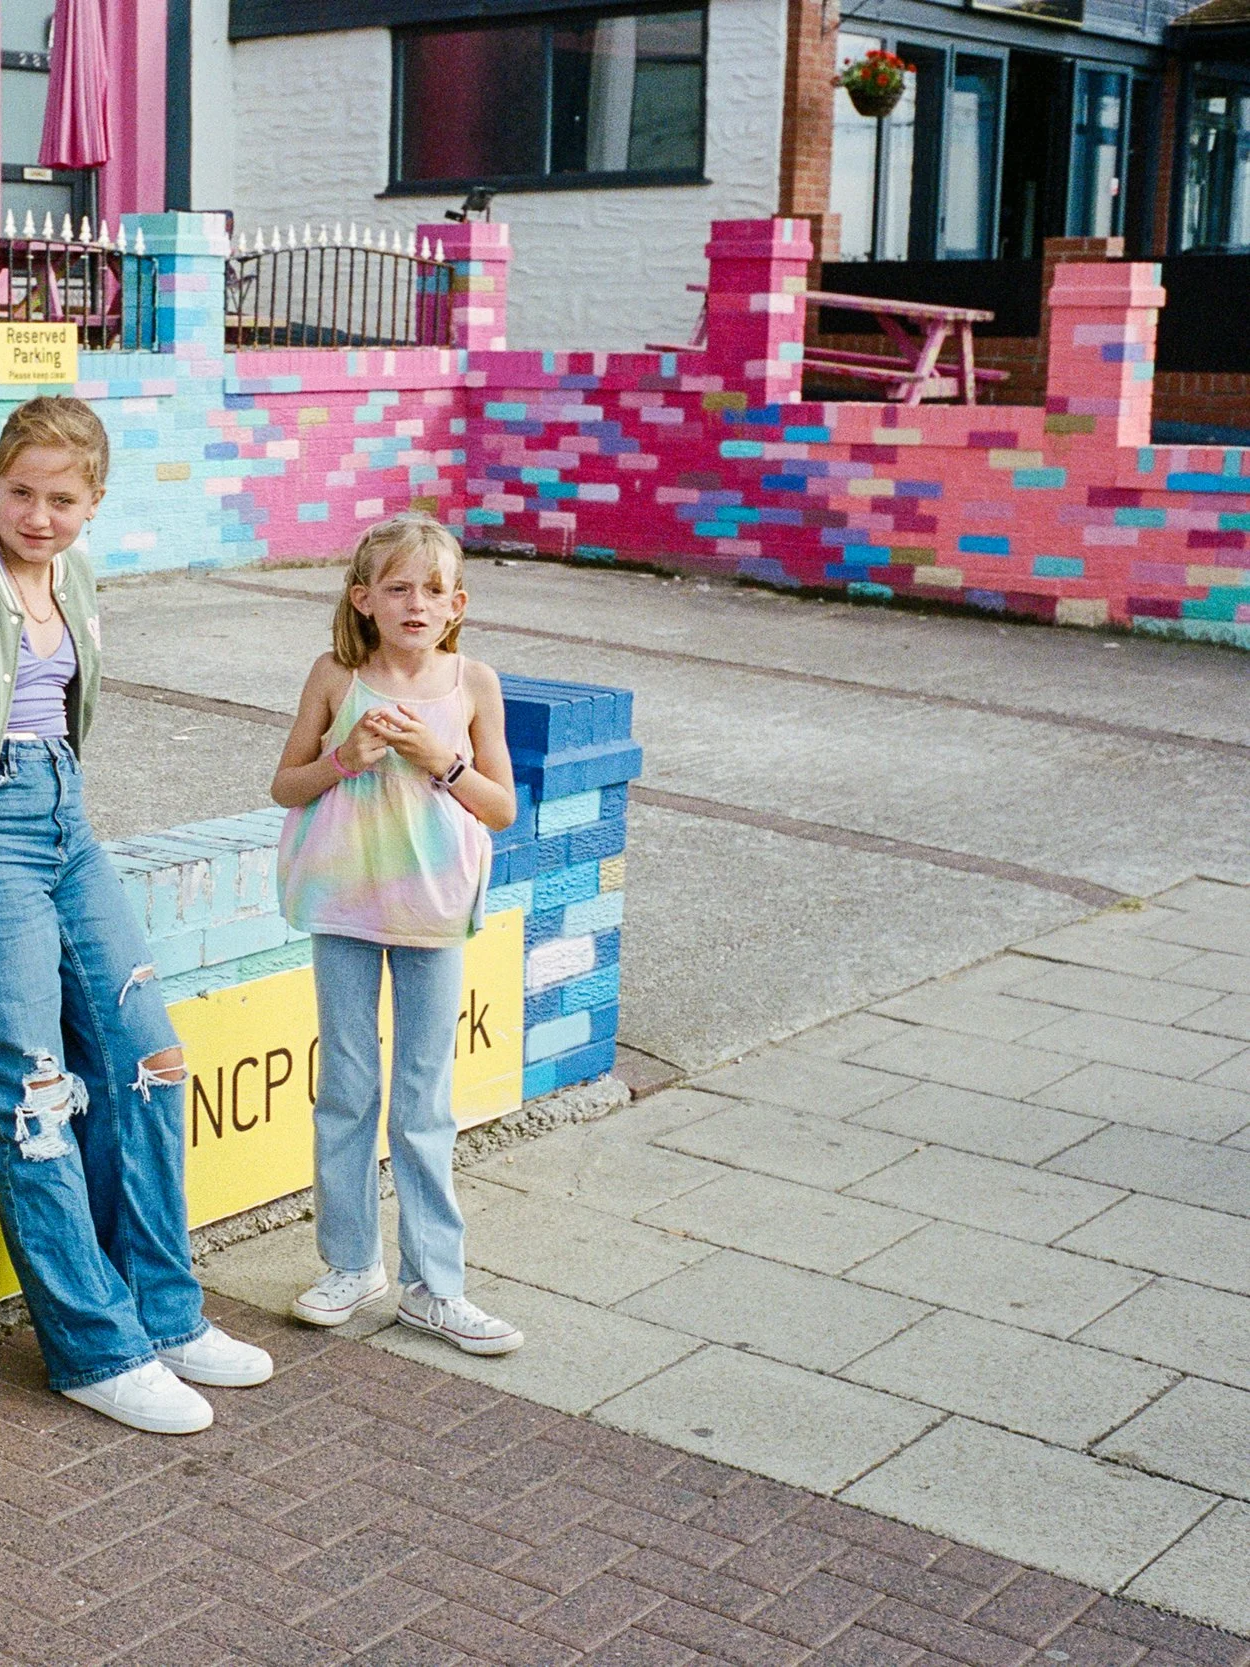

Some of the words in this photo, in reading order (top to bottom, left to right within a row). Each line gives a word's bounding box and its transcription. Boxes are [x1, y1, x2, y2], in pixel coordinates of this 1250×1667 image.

[7, 327, 66, 343] Reserved
[13, 347, 61, 368] Parking
[192, 1047, 293, 1148] NCP
